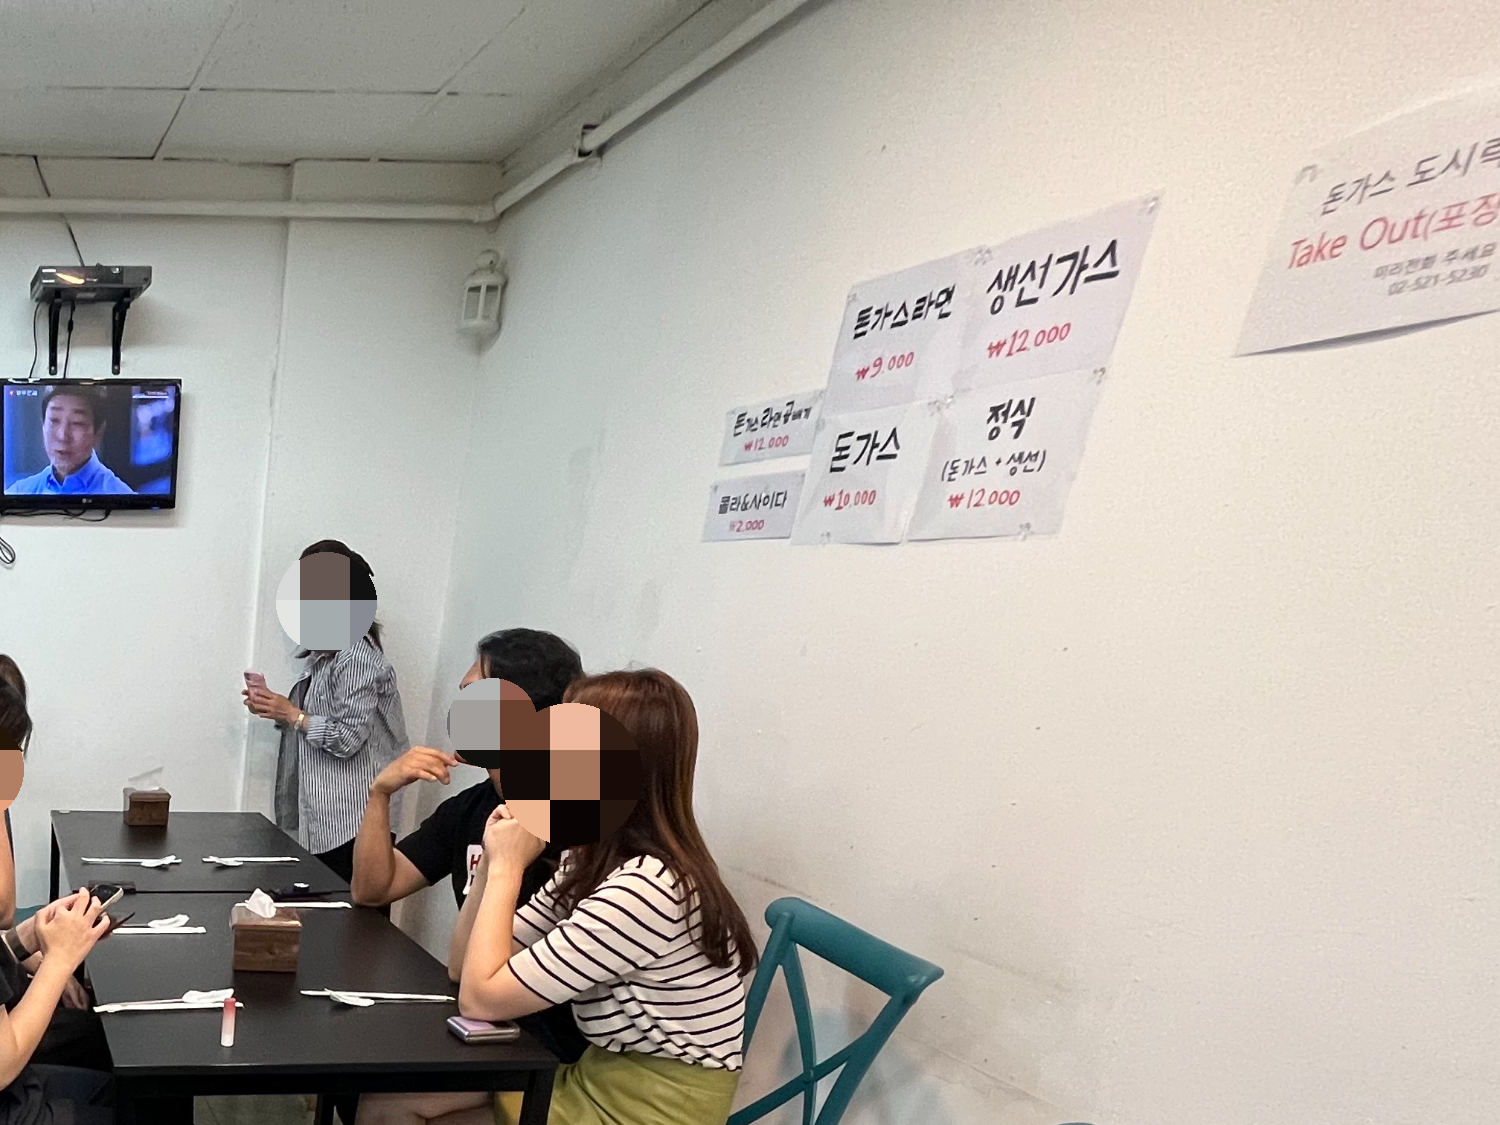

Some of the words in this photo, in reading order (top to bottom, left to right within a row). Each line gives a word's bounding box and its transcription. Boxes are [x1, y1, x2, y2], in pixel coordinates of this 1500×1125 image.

[1321, 171, 1396, 216] 돈가스
[1287, 232, 1347, 269] Take
[986, 239, 1120, 315] 생선가스
[853, 284, 956, 340] 돈가스라면
[986, 397, 1036, 441] 정식
[829, 427, 901, 473] 돈가스
